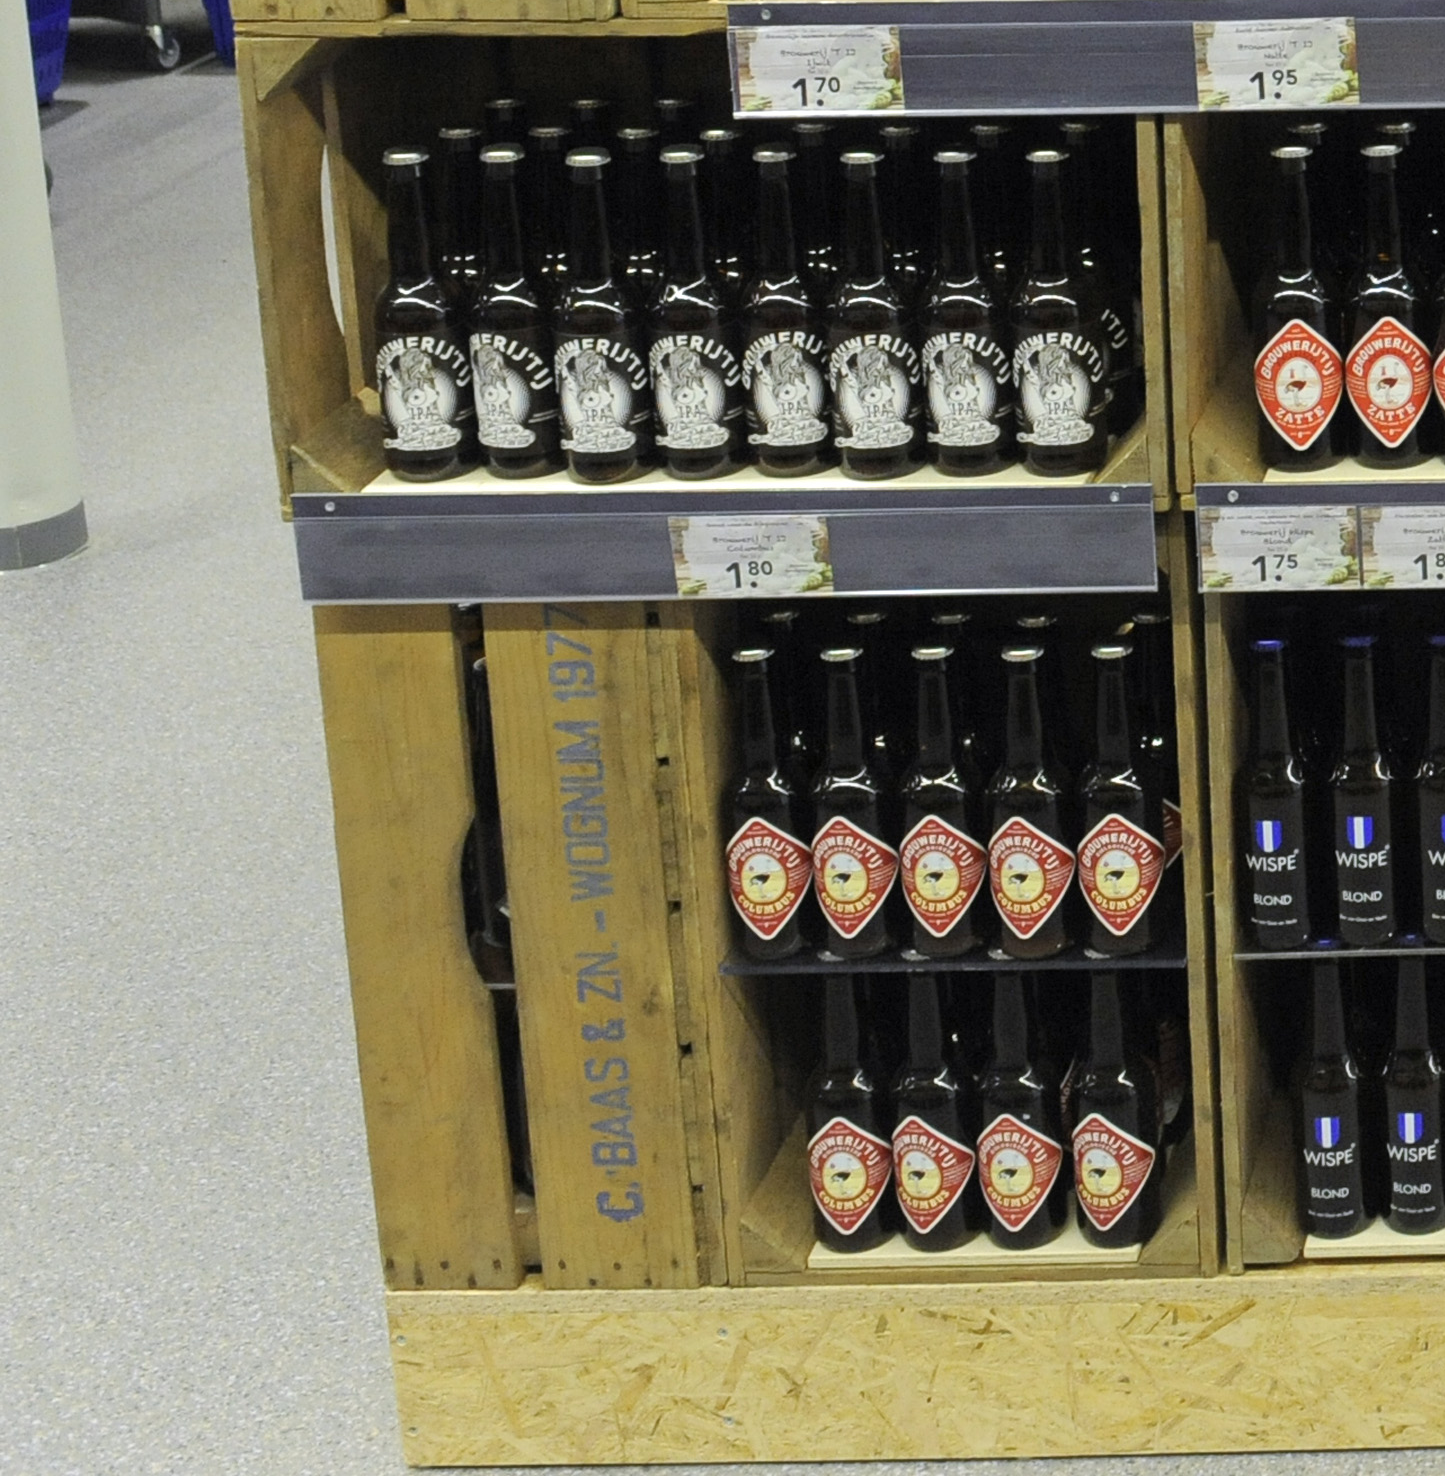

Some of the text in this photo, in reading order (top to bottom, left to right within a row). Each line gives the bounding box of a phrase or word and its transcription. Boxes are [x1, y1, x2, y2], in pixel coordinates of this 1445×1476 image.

[1368, 402, 1419, 421] ZATTE
[544, 604, 598, 703] 1977
[553, 714, 613, 903] WOGNUM
[1246, 852, 1297, 873] WISPE
[910, 890, 969, 913] COLUMBUS
[1253, 893, 1293, 906] BLOND
[584, 1059, 638, 1169] BAAS
[1304, 1148, 1354, 1167] WISPE
[1311, 1186, 1350, 1199] BLOND
